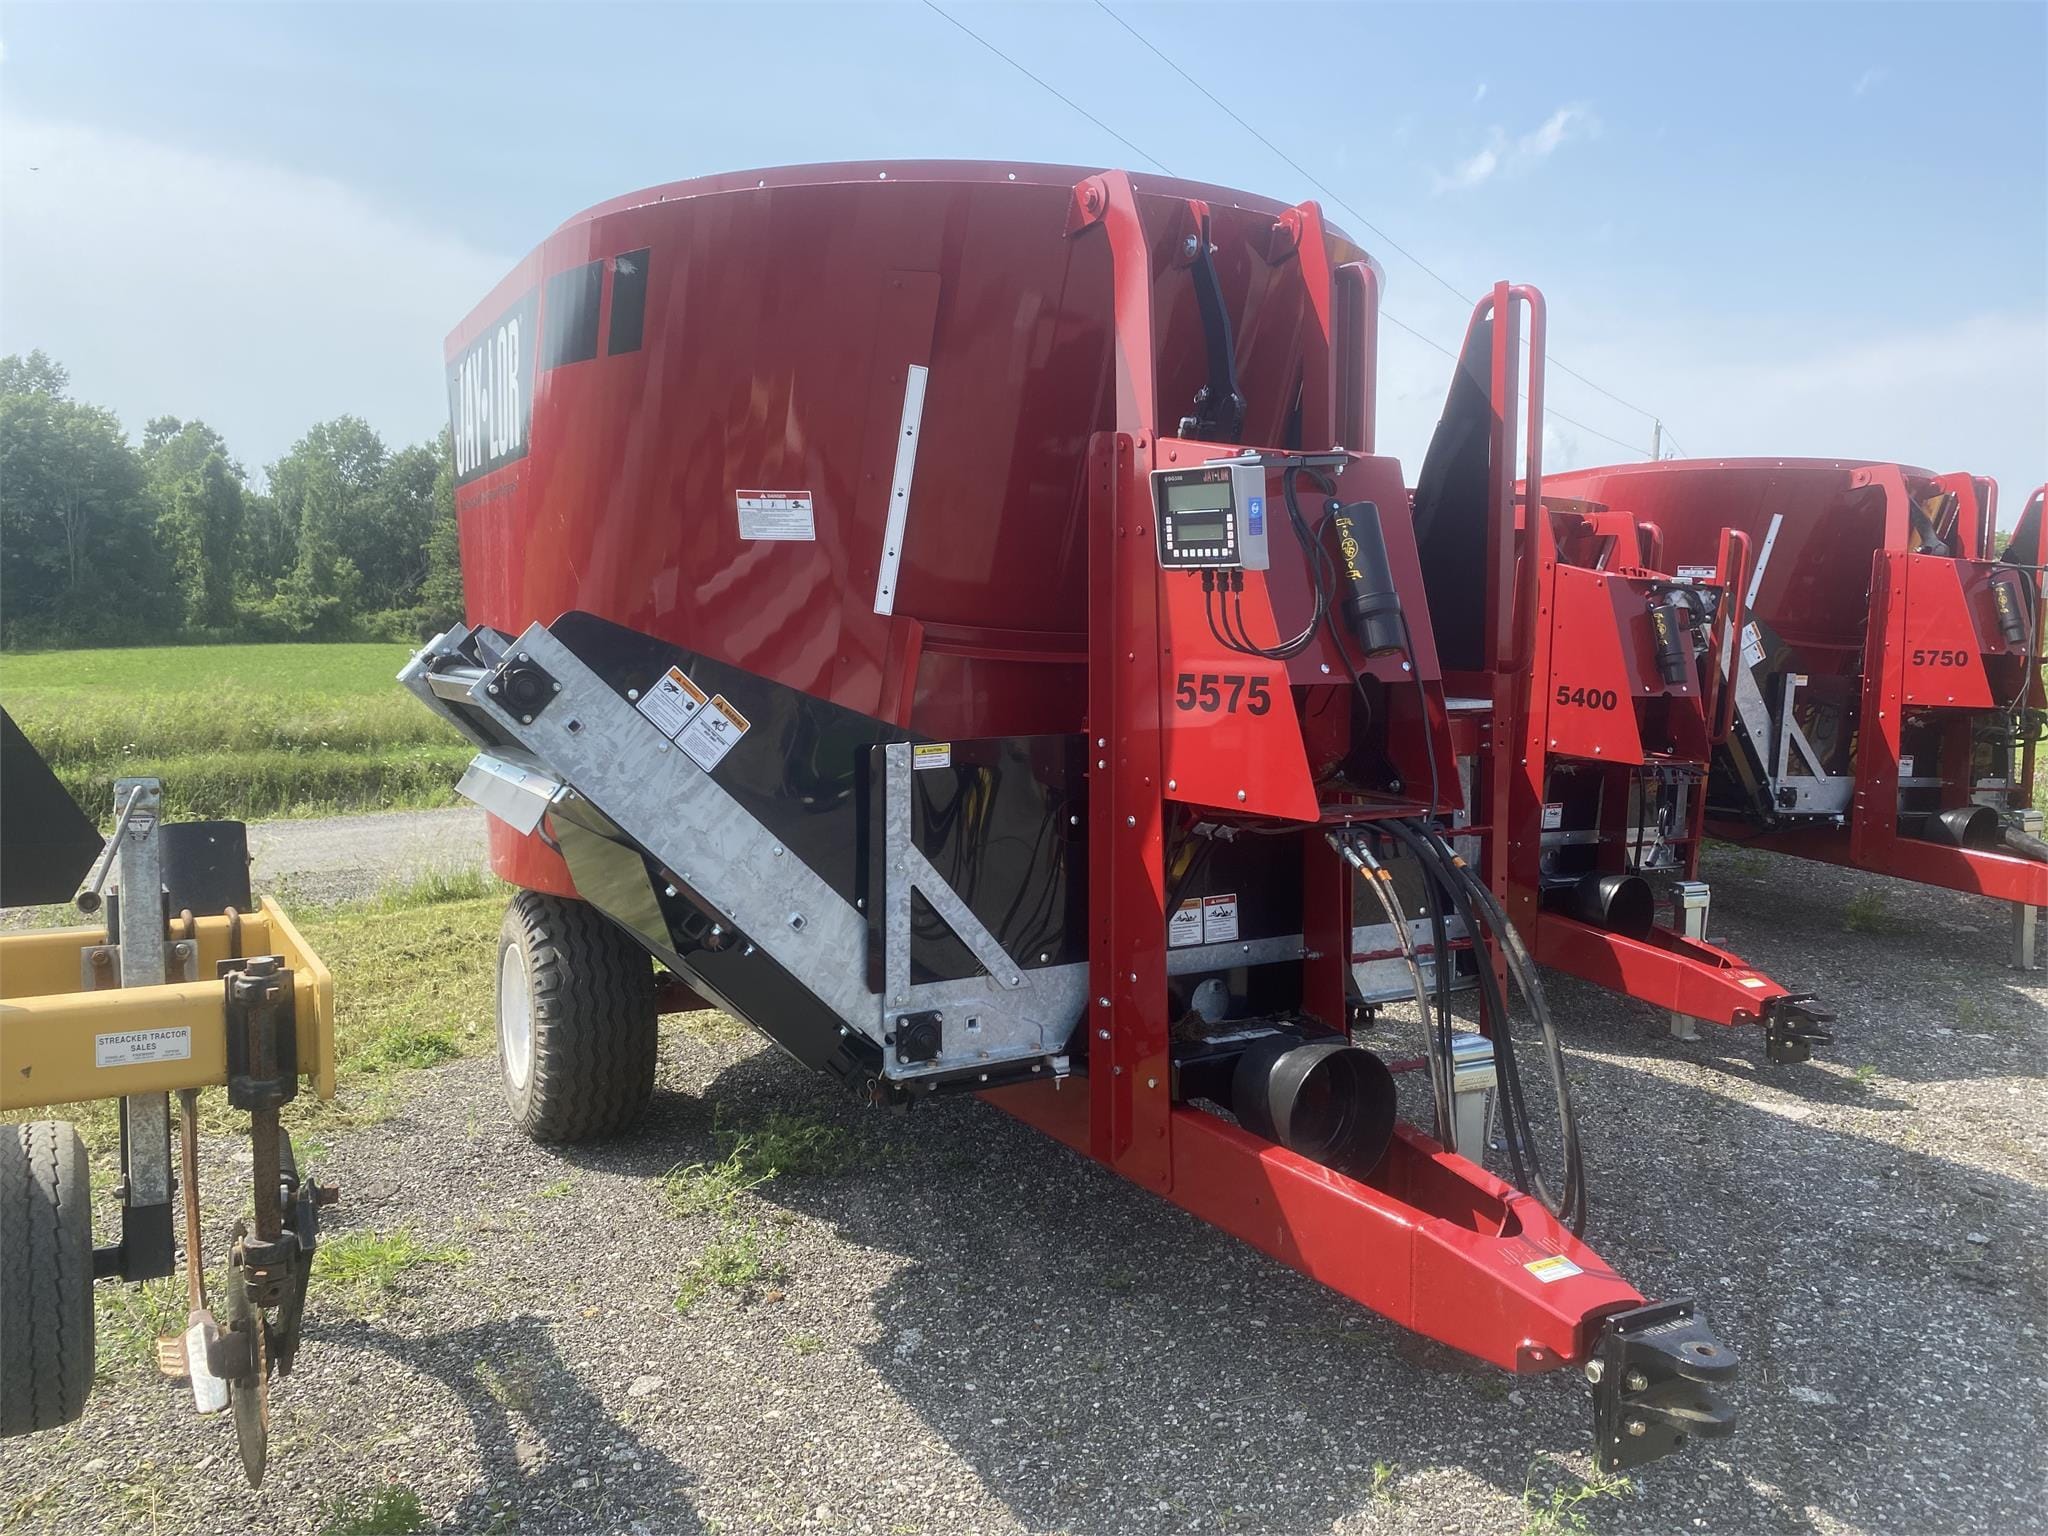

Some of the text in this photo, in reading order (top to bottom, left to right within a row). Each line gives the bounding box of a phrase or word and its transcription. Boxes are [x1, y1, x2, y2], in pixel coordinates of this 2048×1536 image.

[1912, 650, 1969, 667] 5750
[1176, 673, 1271, 716] 5575
[1556, 685, 1617, 711] 5400
[99, 1030, 188, 1046] STREACKER TRACTOR
[130, 1043, 157, 1052] SALES
